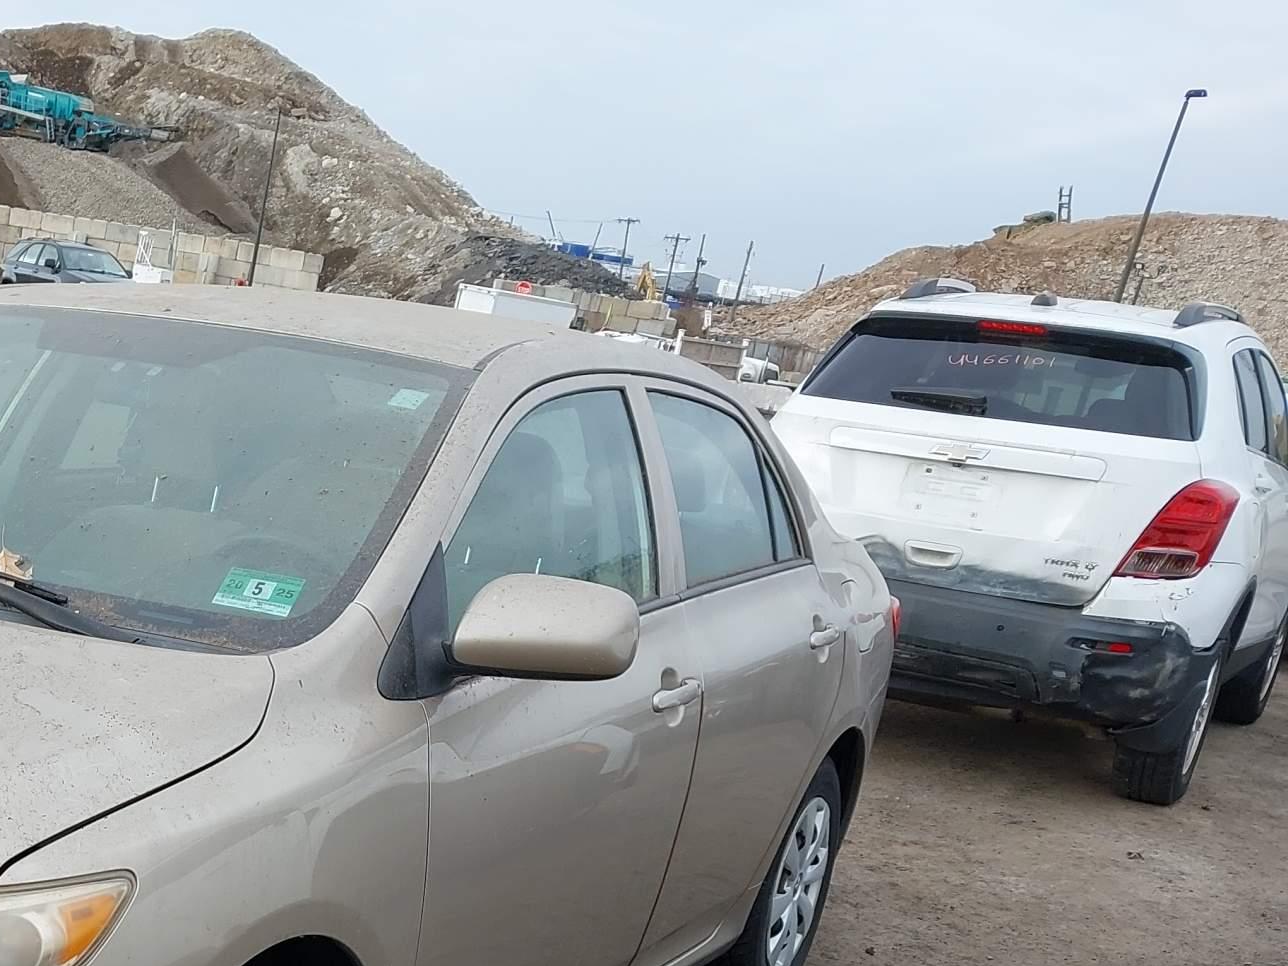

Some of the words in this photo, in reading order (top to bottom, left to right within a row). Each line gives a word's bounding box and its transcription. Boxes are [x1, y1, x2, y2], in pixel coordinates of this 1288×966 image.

[227, 579, 243, 590] 20
[252, 581, 266, 596] 5
[275, 588, 295, 599] 25
